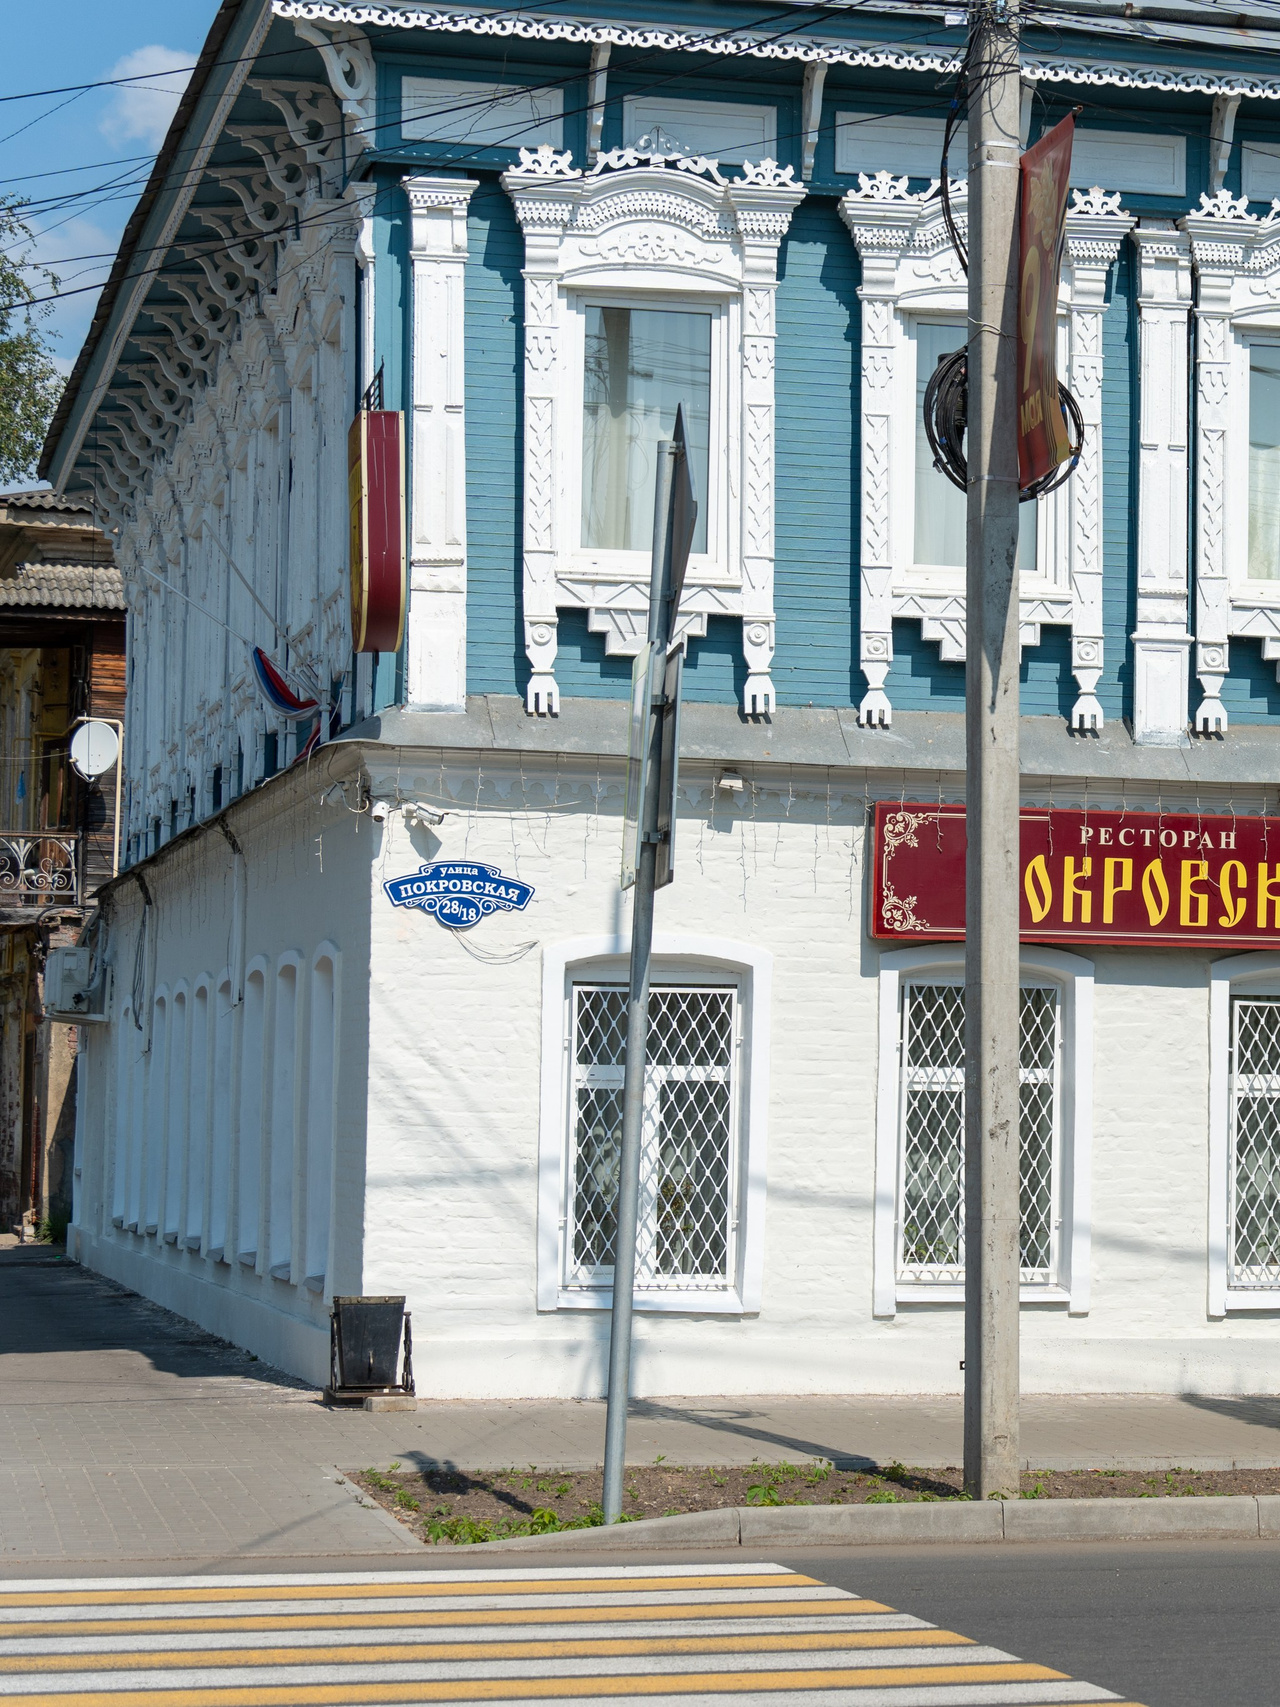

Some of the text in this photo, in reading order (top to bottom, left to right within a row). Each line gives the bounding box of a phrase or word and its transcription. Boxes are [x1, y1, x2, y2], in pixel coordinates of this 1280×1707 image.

[1021, 245, 1041, 393] 9
[1079, 825, 1238, 850] РЕСТОРАН
[439, 866, 478, 877] улица
[399, 879, 521, 902] ПОКРОВСКАЯ
[442, 901, 477, 921] 28/18
